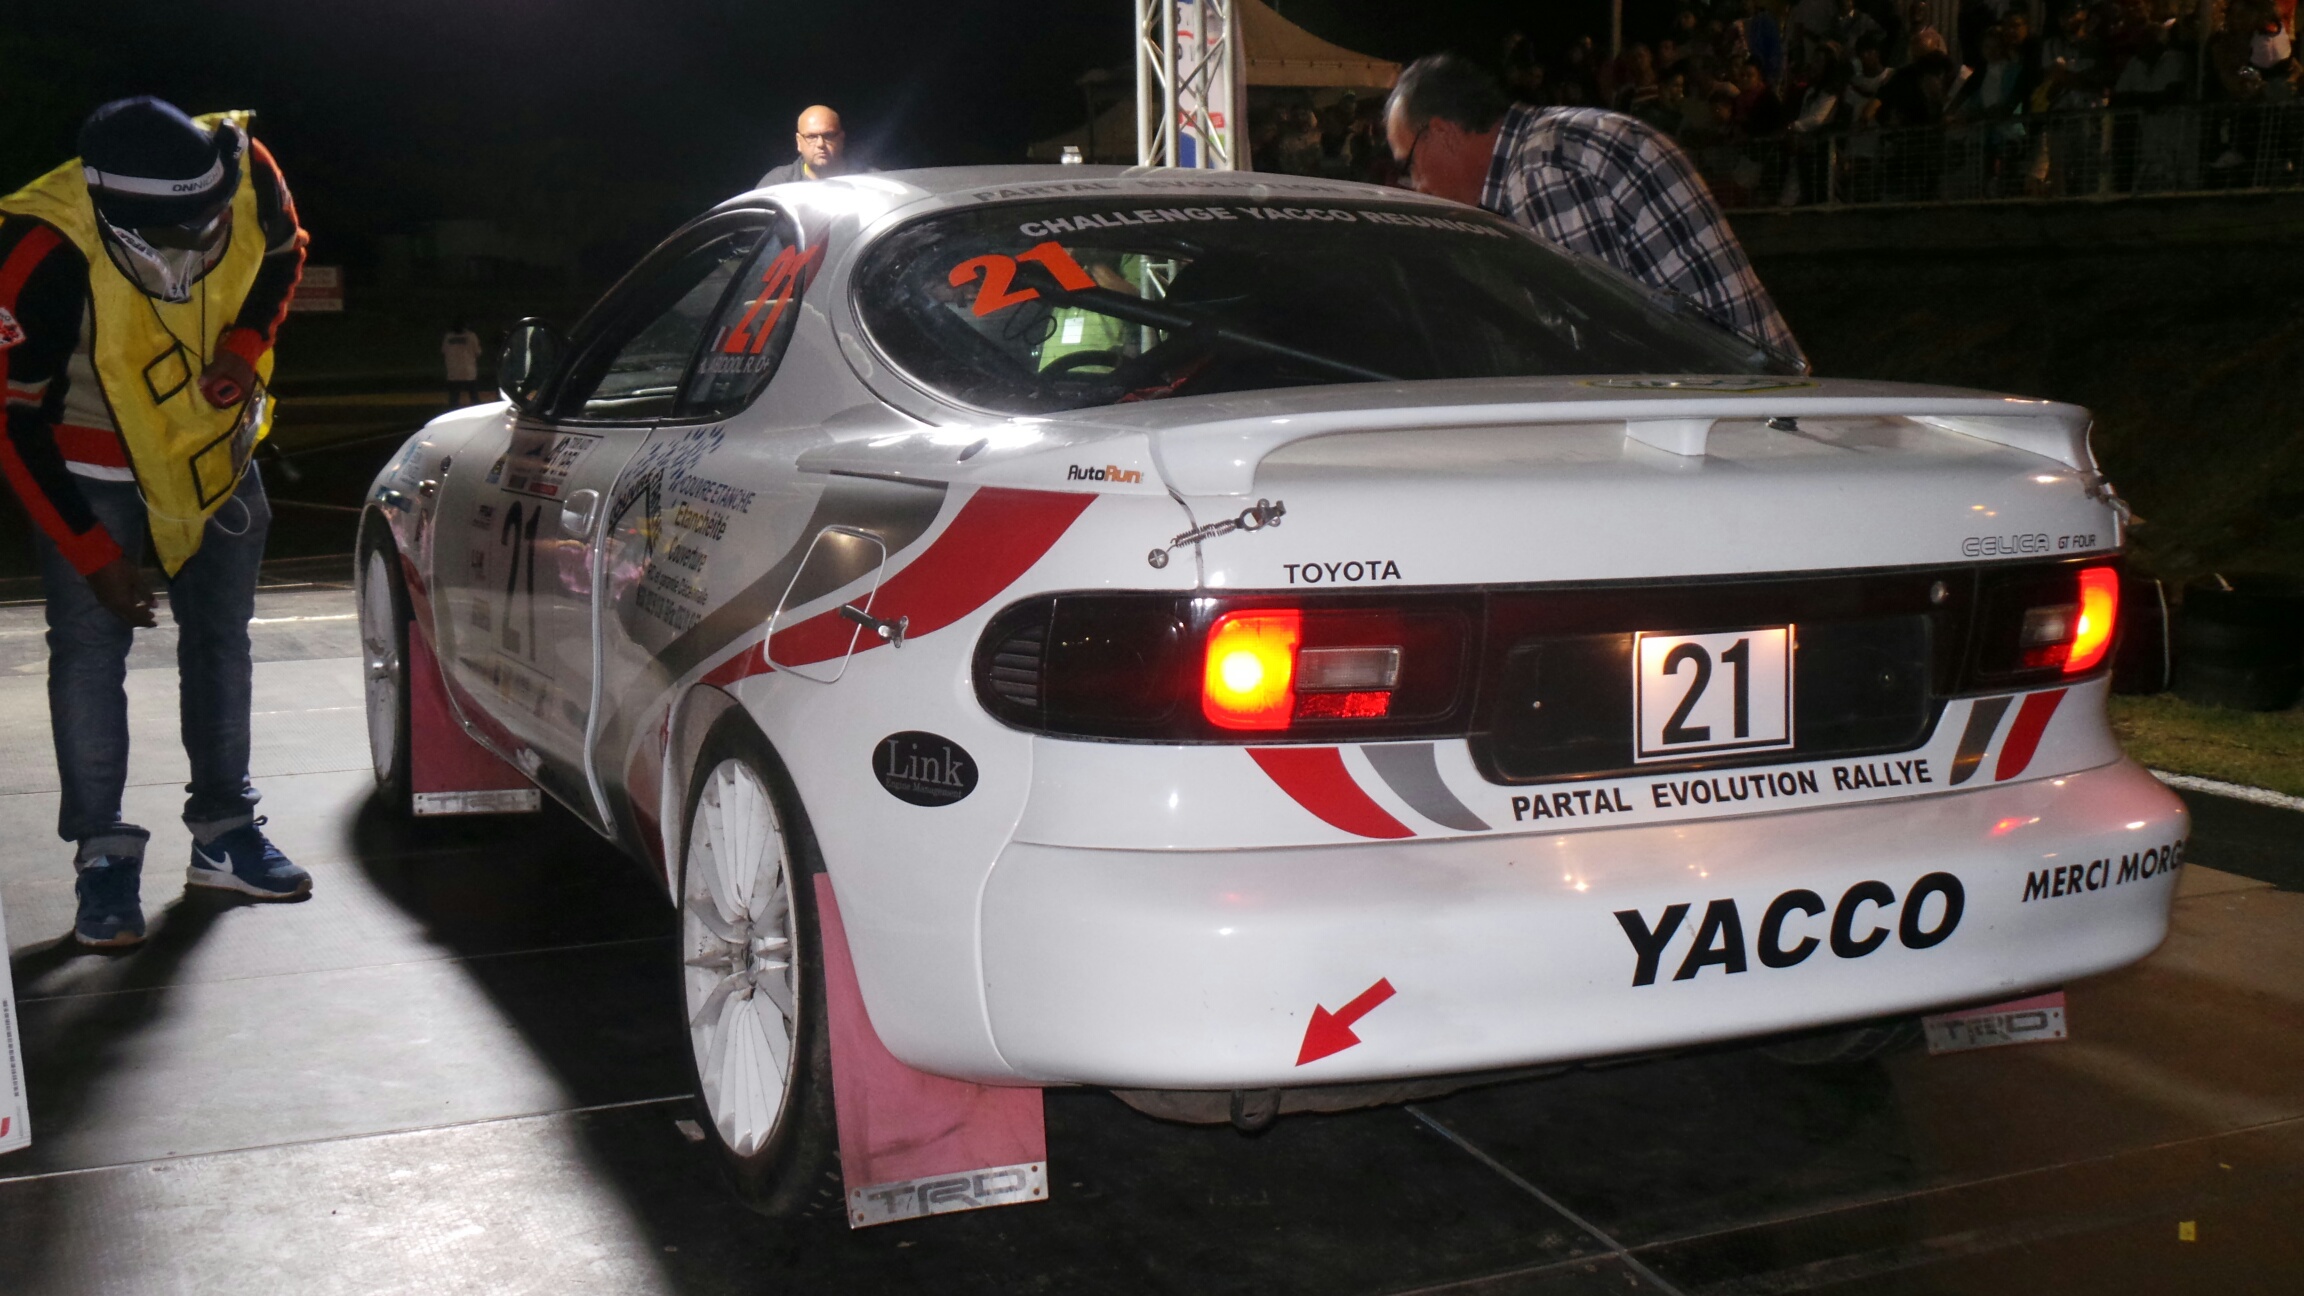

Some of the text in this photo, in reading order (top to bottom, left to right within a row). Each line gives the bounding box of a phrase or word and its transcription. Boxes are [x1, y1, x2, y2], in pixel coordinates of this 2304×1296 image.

[971, 181, 1121, 202] PARTAL
[1019, 206, 1510, 240] CHALLENGE YACCO REUNION
[723, 244, 820, 355] 21
[948, 240, 1097, 319] 21
[1066, 464, 1142, 484] AutoRun
[1962, 533, 2097, 557] CELICA GT FOUR
[500, 500, 542, 663] 21
[1283, 559, 1402, 585] TOYOTA
[1661, 637, 1751, 746] 21
[886, 739, 964, 788] Link
[1511, 758, 1933, 822] PARTAL EVOLUTION RALLYE
[2021, 858, 2110, 903] MERCI
[1613, 870, 1966, 988] YACCO
[867, 1167, 1027, 1215] TRD
